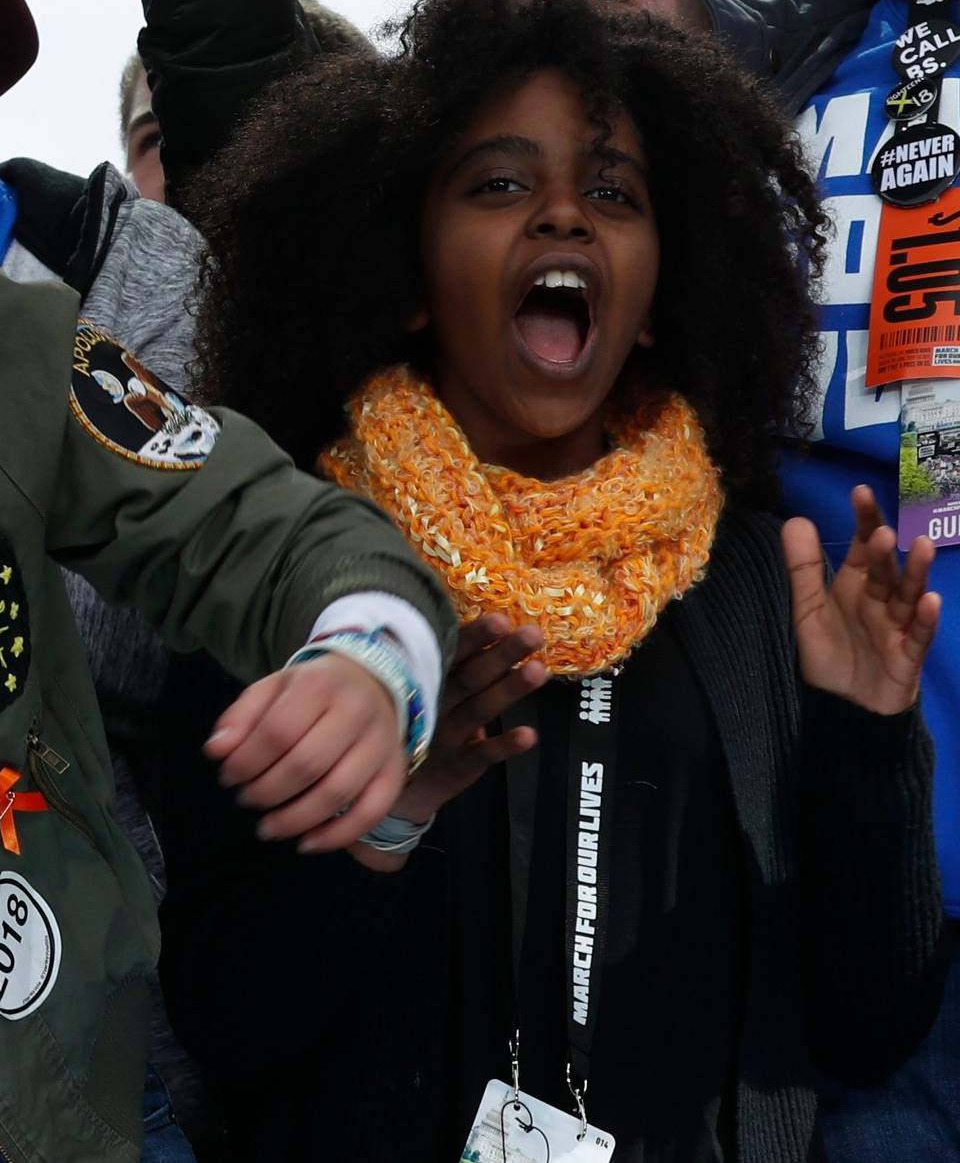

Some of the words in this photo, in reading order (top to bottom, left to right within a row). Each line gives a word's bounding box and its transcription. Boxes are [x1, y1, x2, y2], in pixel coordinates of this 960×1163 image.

[896, 22, 931, 48] WE
[900, 28, 960, 64] CALL
[881, 134, 955, 167] #NEVER
[880, 153, 954, 192] AGAIN
[929, 515, 960, 541] GU
[579, 761, 604, 831] LIVES
[577, 831, 599, 884] OUR
[576, 884, 597, 935] FOR
[573, 934, 594, 1026] MARCH
